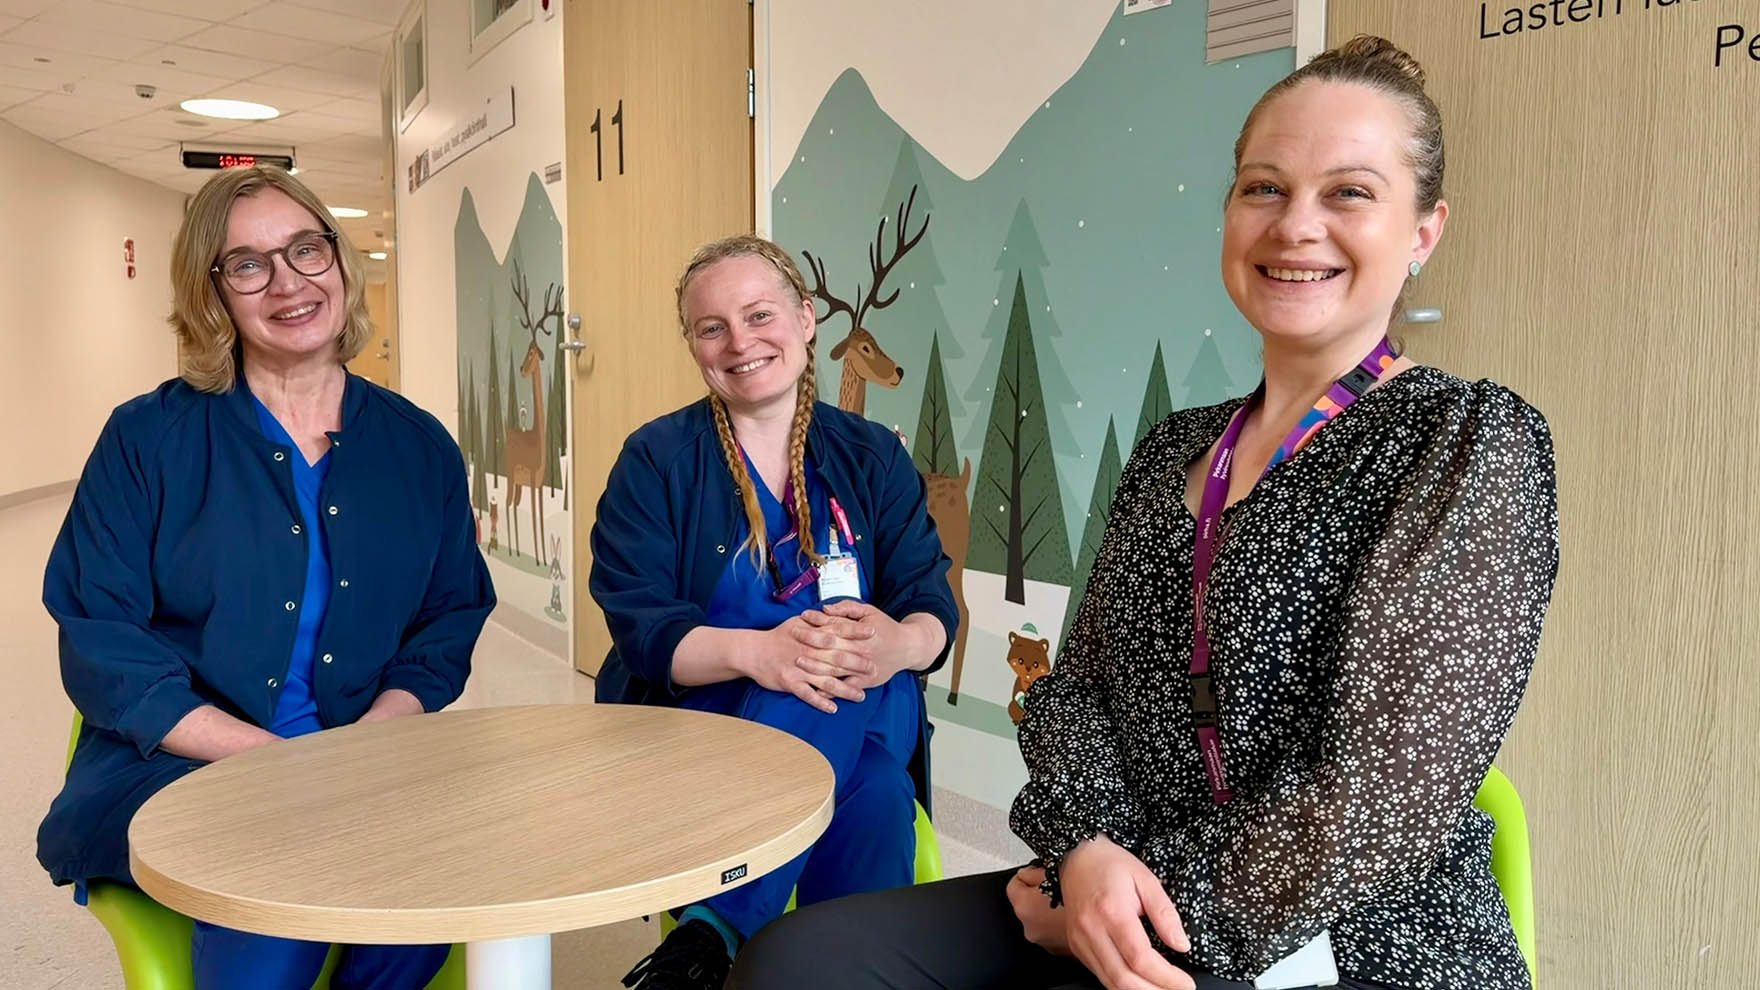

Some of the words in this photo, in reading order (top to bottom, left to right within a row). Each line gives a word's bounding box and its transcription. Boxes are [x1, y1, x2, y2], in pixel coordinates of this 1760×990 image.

[1480, 0, 1622, 39] Lasten
[590, 99, 624, 182] 11
[724, 866, 745, 882] ISKU
